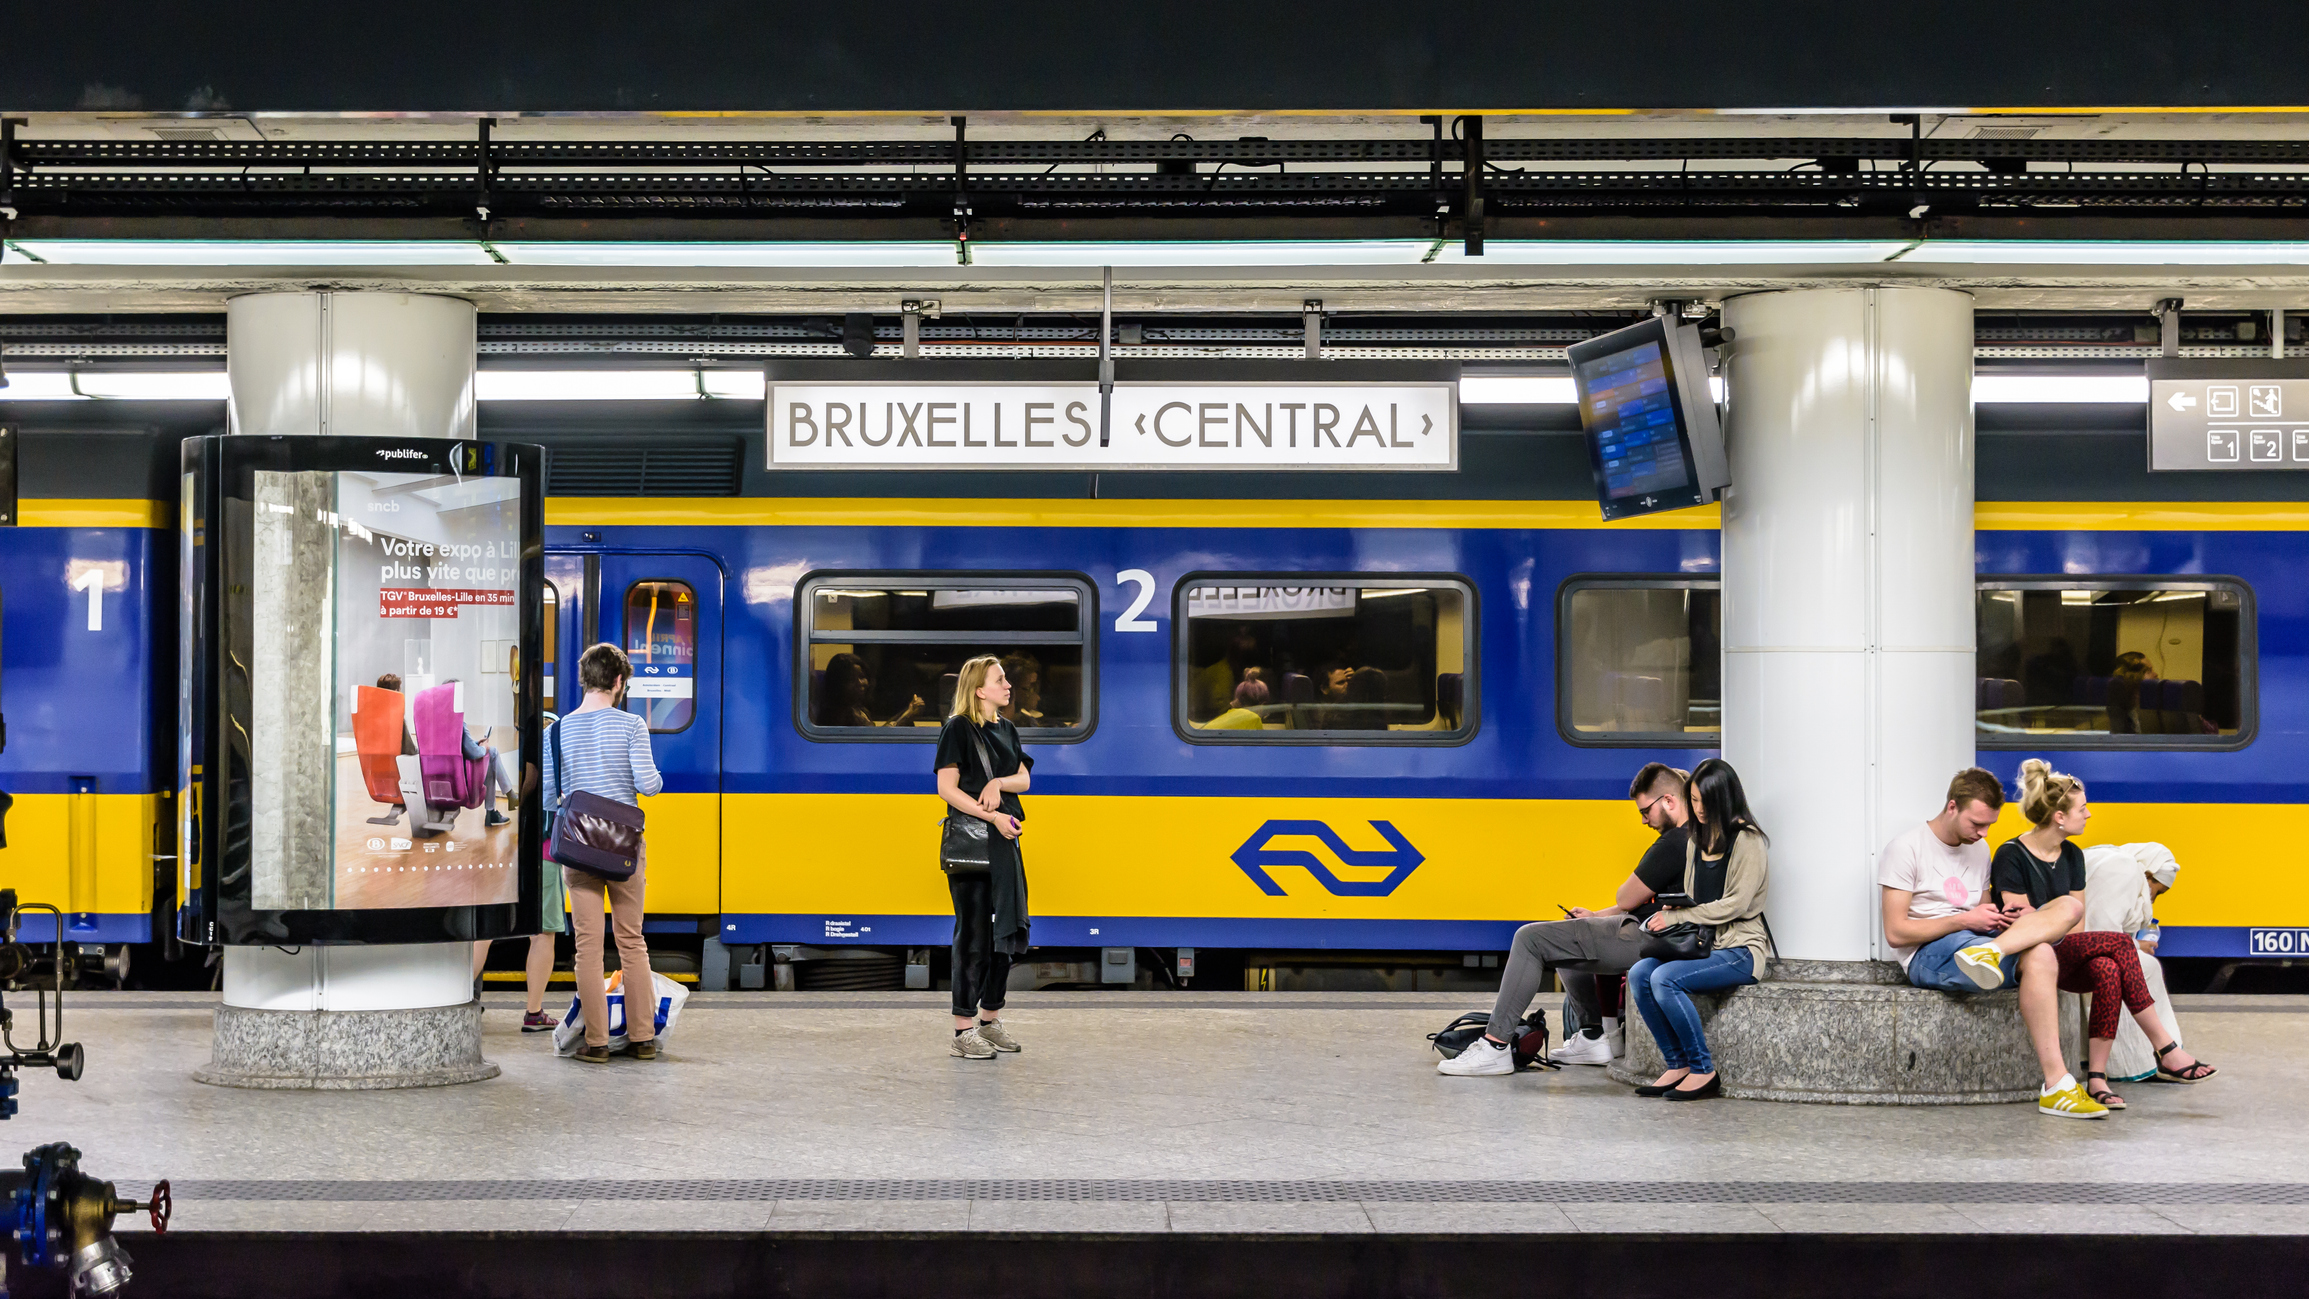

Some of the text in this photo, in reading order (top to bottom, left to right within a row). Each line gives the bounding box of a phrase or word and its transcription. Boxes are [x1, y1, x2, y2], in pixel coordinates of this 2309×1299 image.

[788, 401, 1092, 448] BRUXELLES
[384, 448, 423, 461] publifer
[2227, 440, 2277, 457] 1 2
[367, 500, 400, 512] sncb
[380, 537, 434, 557] Votre
[439, 543, 482, 562] expo
[486, 540, 496, 558] à
[381, 560, 422, 584] plus
[426, 561, 460, 580] vite
[465, 567, 496, 585] que
[72, 569, 104, 631] 1
[408, 591, 473, 602] Bruxelles-Lille
[475, 594, 486, 602] en
[487, 593, 498, 602] 35
[499, 592, 515, 603] min
[1114, 568, 1158, 632] 2
[380, 605, 387, 615] à
[389, 605, 418, 617] partir
[419, 605, 432, 615] de
[434, 606, 445, 616] 19
[2253, 931, 2293, 952] 160
